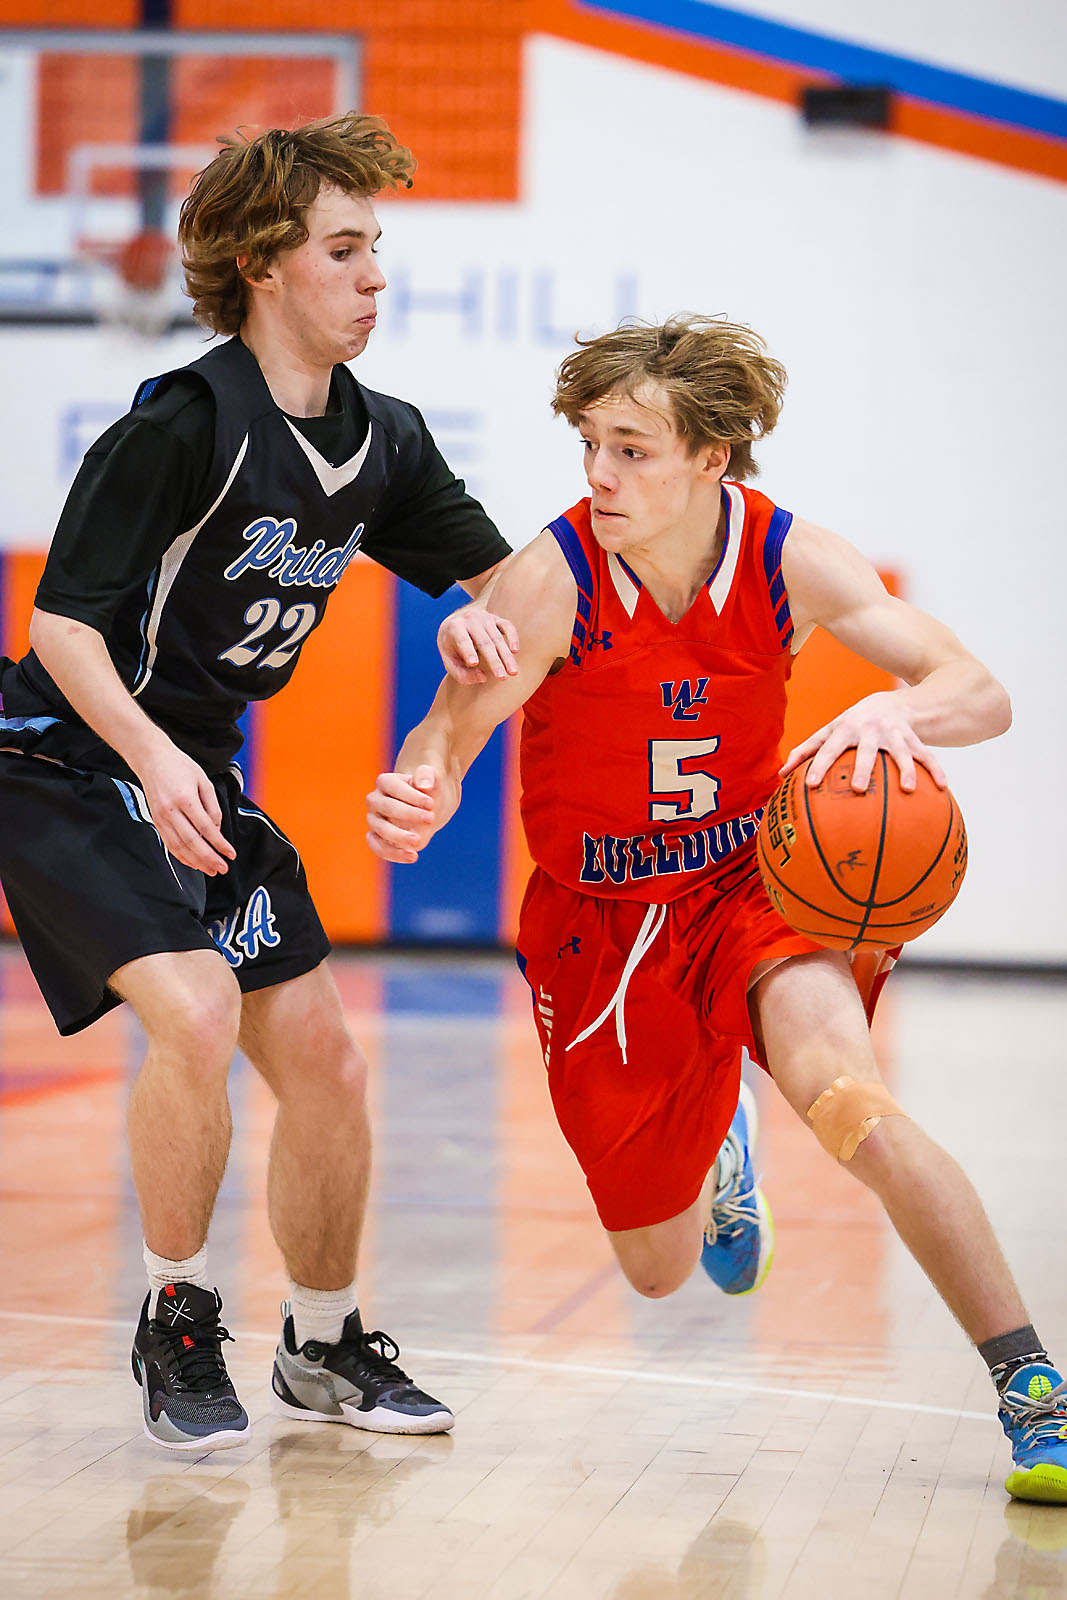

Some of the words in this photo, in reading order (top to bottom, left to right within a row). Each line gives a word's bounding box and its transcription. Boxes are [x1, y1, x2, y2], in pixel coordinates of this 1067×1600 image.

[224, 516, 365, 588] Prid
[217, 597, 317, 670] 22
[648, 734, 721, 824] 5
